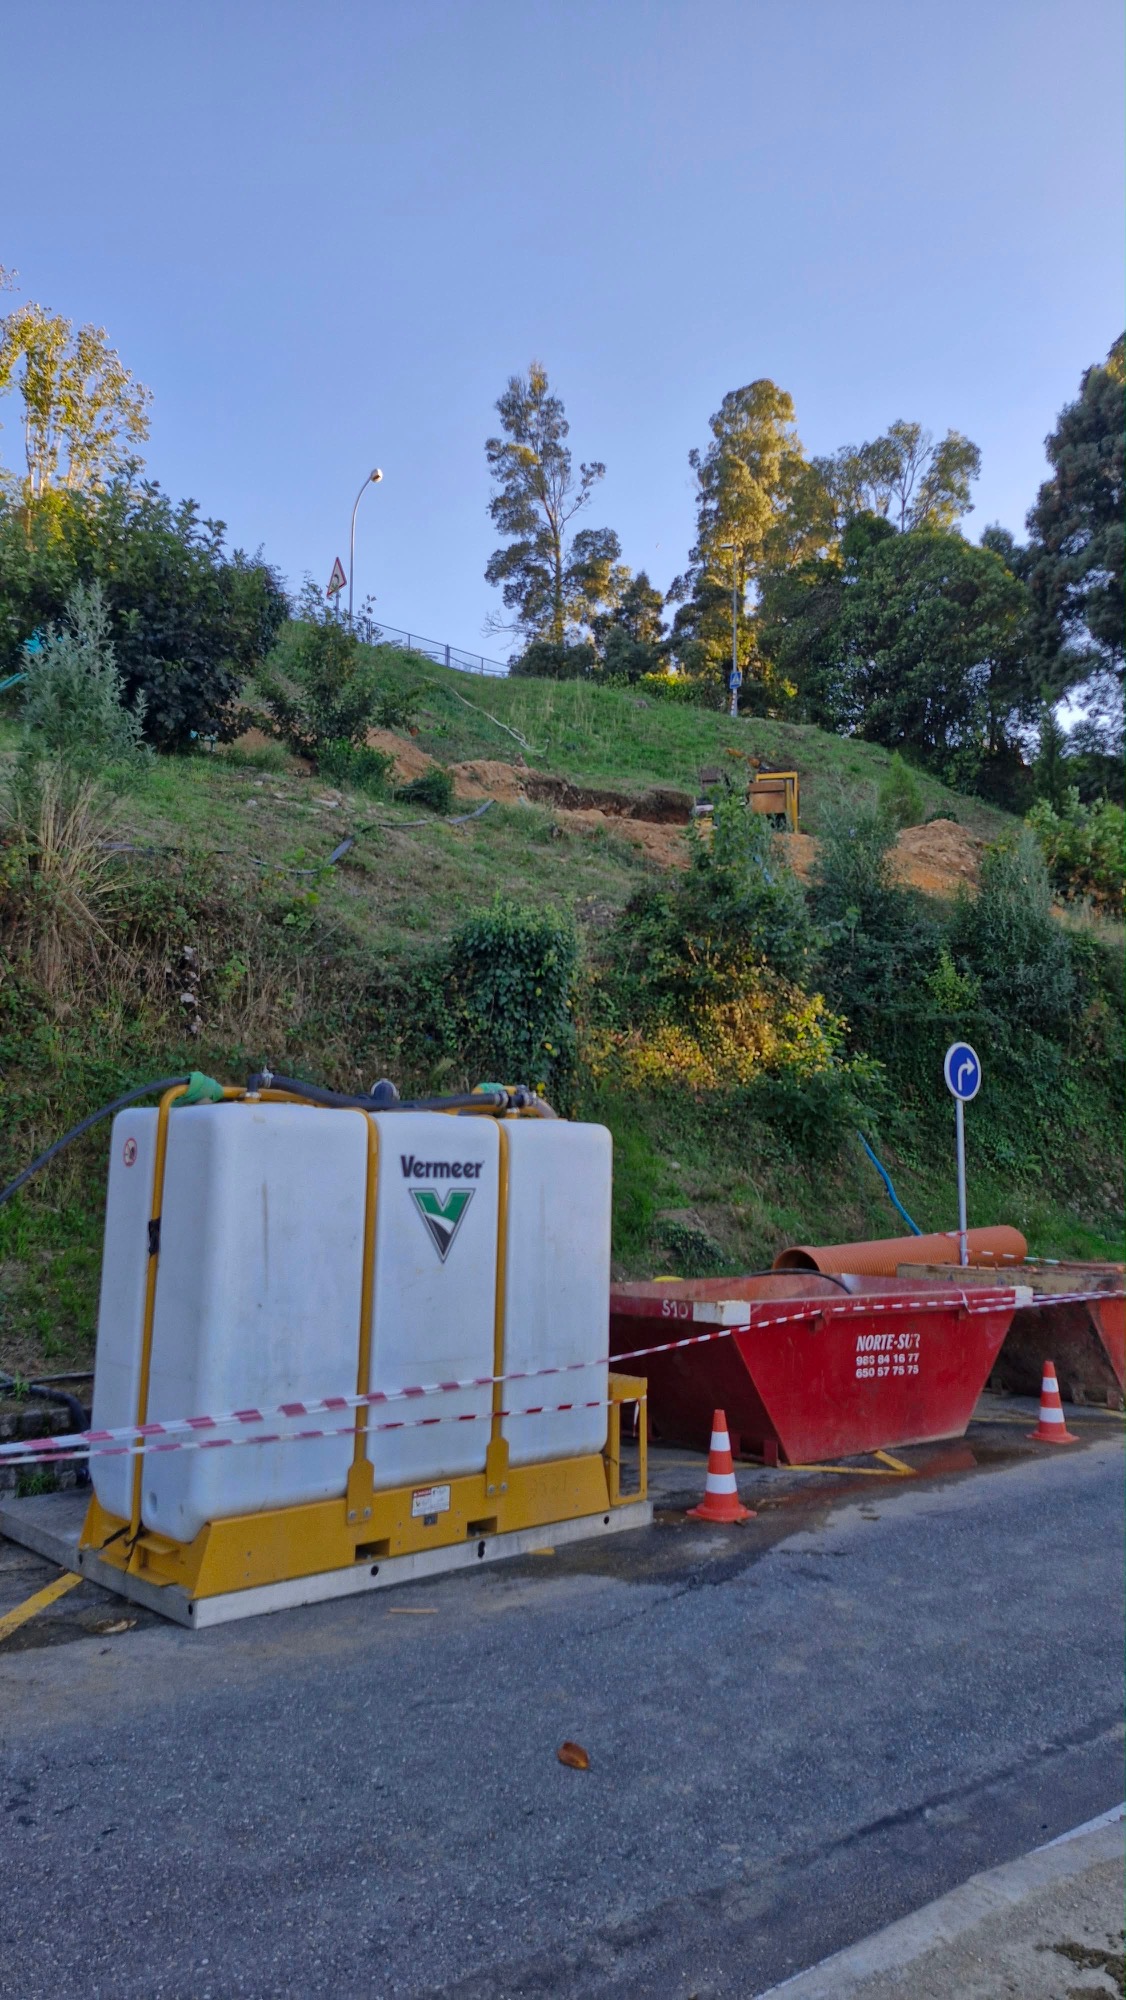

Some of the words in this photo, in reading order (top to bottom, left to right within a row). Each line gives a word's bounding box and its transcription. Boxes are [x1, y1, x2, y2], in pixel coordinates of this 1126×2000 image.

[400, 1155, 482, 1179] Vermeer
[893, 1353, 905, 1363] 16
[907, 1352, 920, 1363] 77
[855, 1367, 875, 1379] 650
[877, 1366, 890, 1377] 57
[907, 1364, 919, 1375] 75
